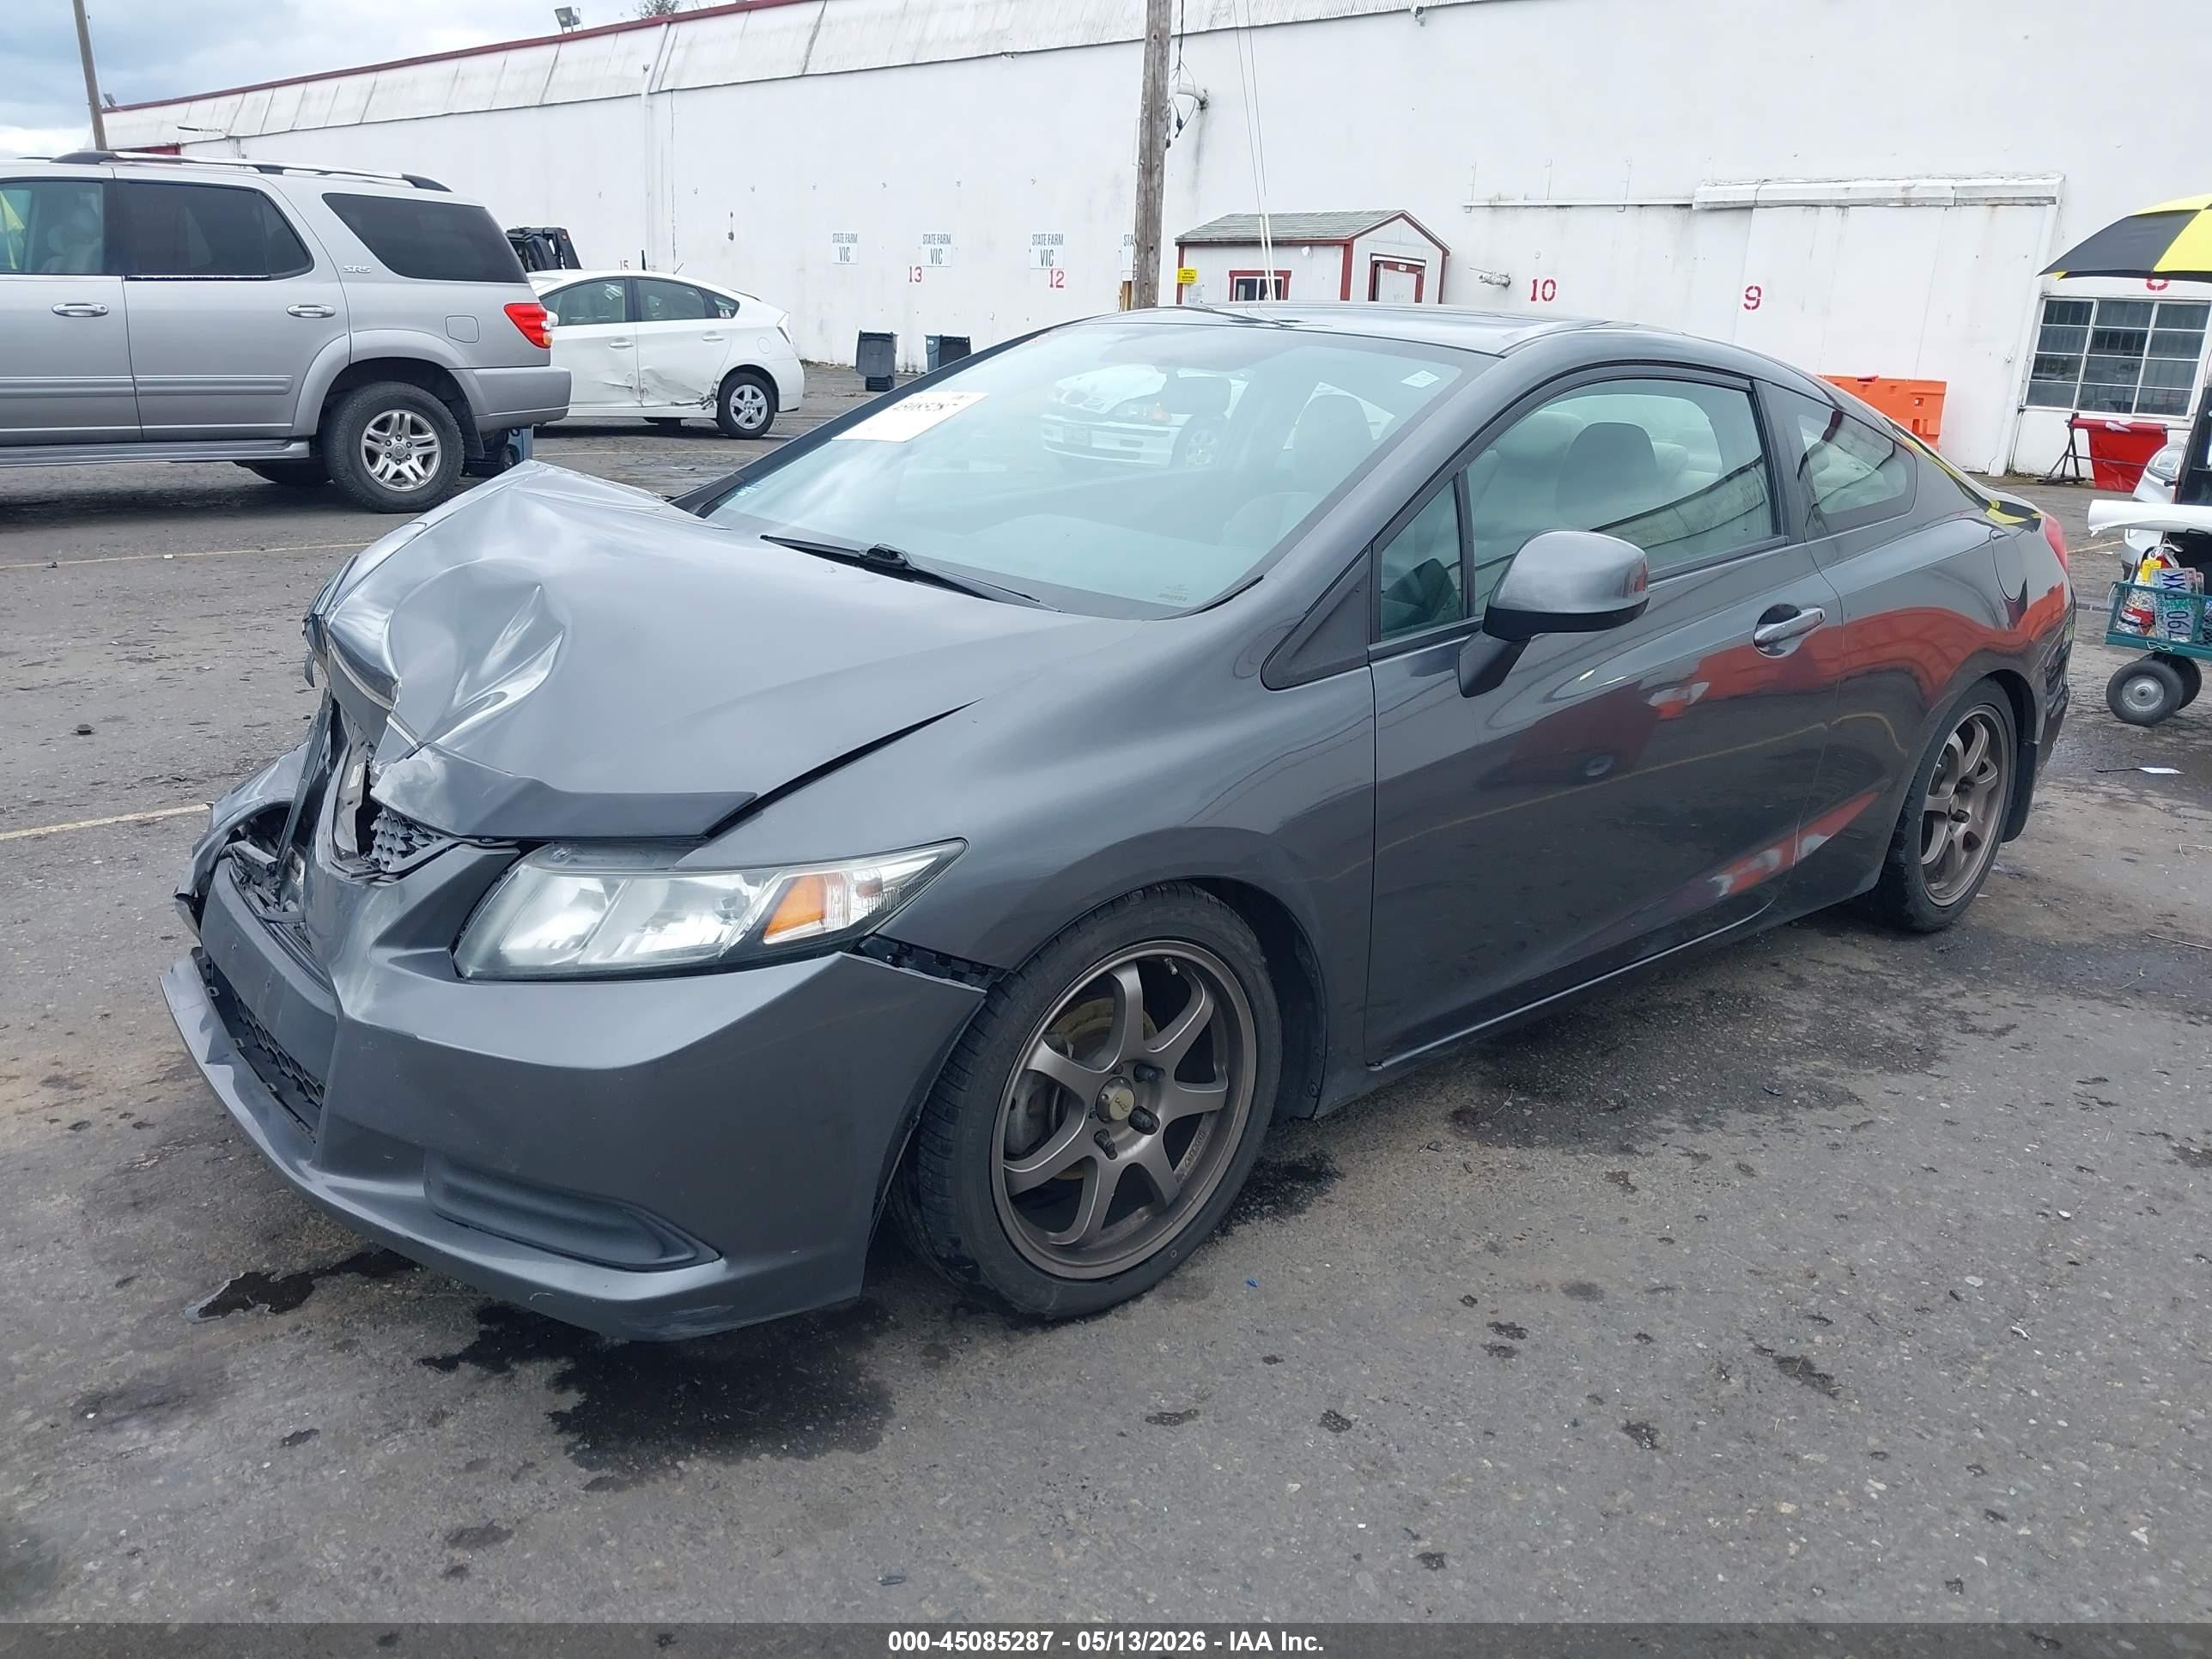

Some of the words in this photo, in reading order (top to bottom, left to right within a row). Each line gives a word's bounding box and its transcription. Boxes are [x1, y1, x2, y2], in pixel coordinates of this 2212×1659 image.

[832, 233, 844, 244] STATE
[845, 233, 858, 244] FARM
[922, 233, 936, 246] STATE
[937, 233, 951, 245] FARM
[1031, 233, 1047, 246] STATE
[1048, 233, 1064, 246] FARM
[1123, 234, 1134, 247] STA
[838, 246, 850, 262] VIC
[930, 247, 943, 265] VIC
[1040, 249, 1054, 267] VIC
[908, 265, 922, 283] 13
[1049, 269, 1065, 289] 12
[1529, 278, 1557, 302] 10
[1742, 285, 1762, 311] 9
